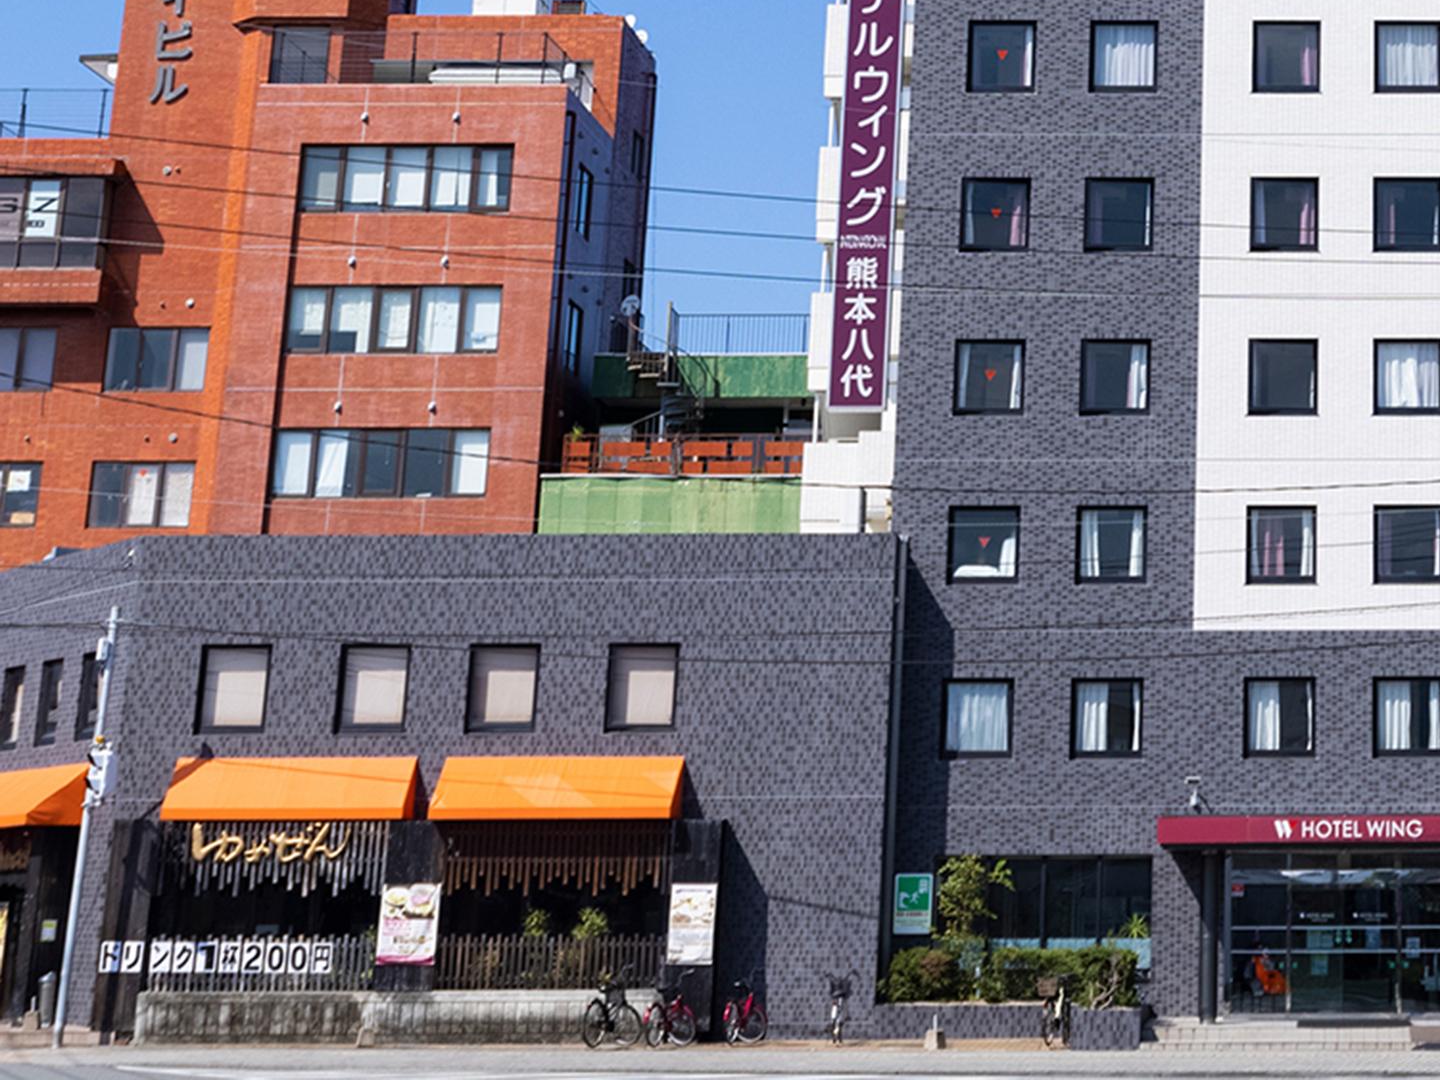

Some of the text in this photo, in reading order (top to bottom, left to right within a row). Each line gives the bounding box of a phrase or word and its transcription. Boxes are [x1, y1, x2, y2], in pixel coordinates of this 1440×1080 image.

[840, 256, 880, 398] 熊本八代
[1301, 820, 1362, 838] HOTEL
[1366, 819, 1424, 838] WING
[101, 944, 330, 971] ドリンク1杯200円
